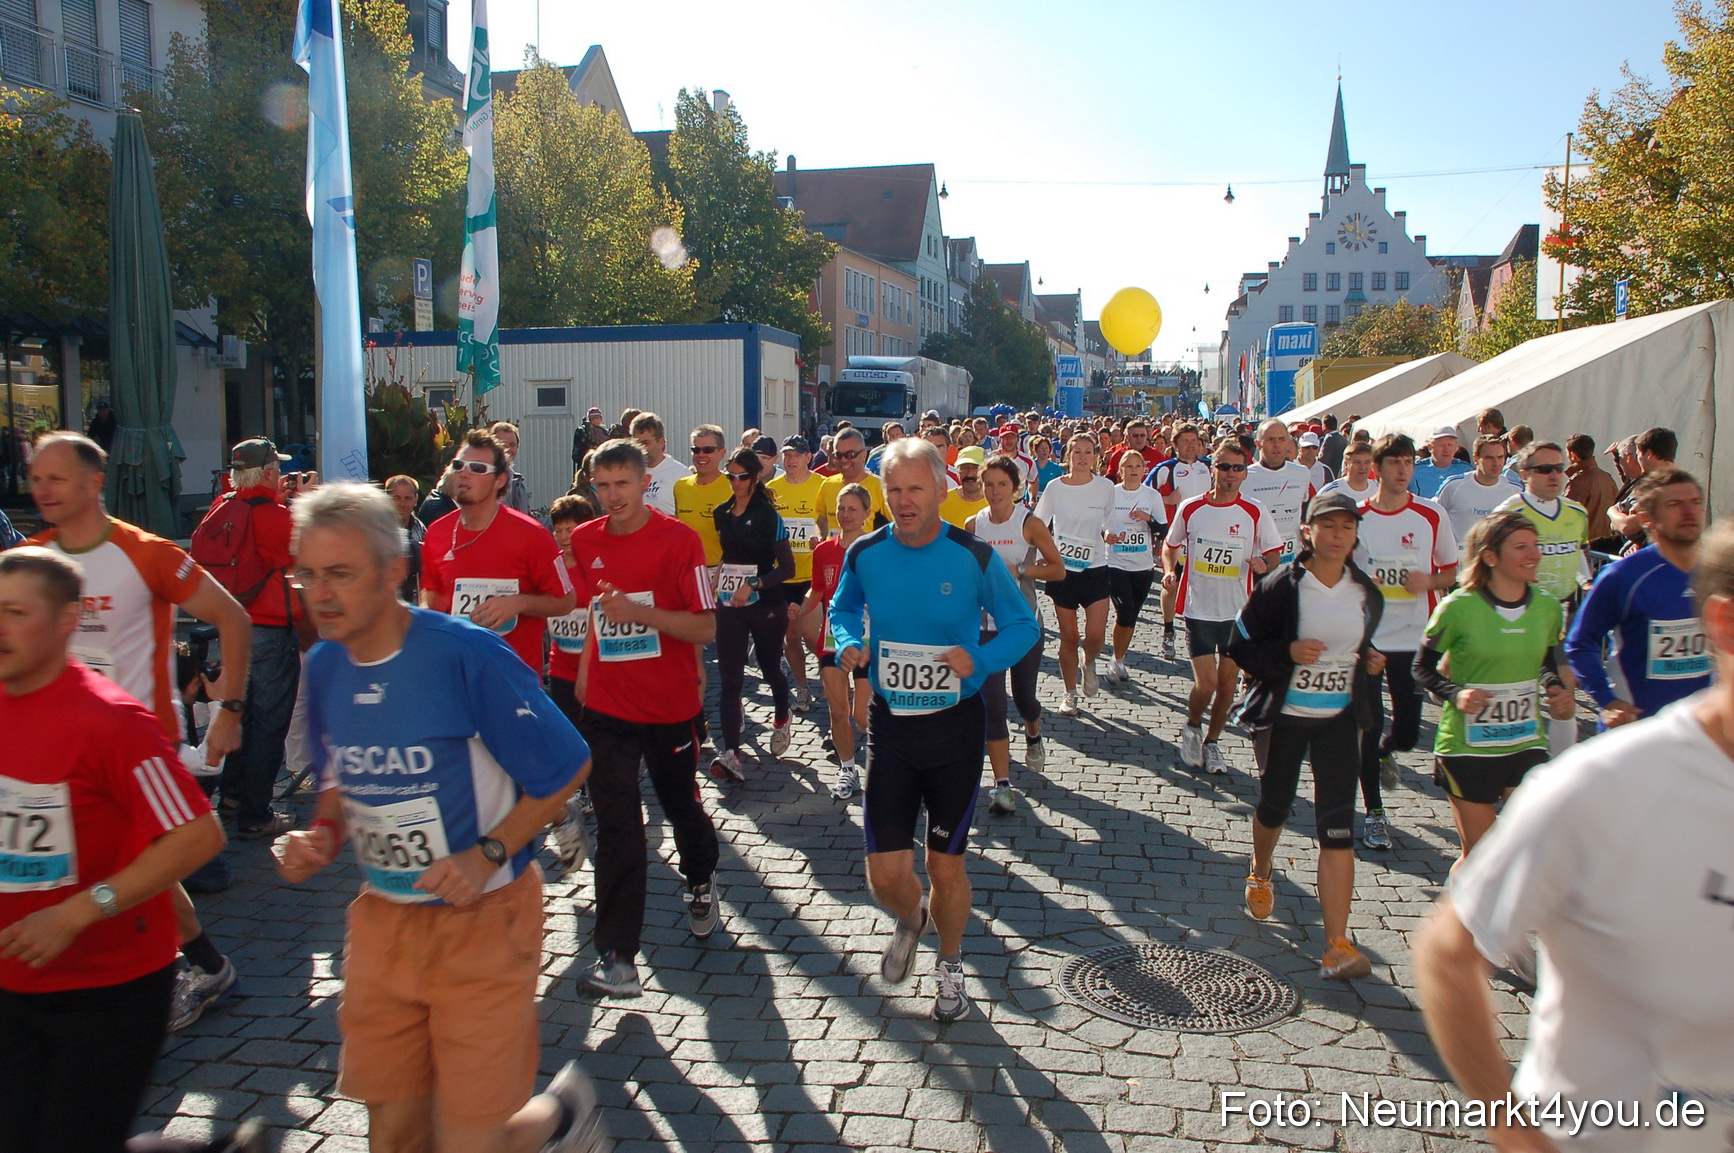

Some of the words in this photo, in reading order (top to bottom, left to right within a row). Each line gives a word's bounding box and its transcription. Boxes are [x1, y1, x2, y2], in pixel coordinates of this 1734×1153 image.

[417, 263, 428, 292] P
[1618, 285, 1625, 311] P
[1277, 331, 1313, 350] maxi
[1060, 361, 1077, 374] axi
[1060, 542, 1091, 561] 2260
[1203, 547, 1233, 565] 475
[1207, 563, 1226, 574] Ralf
[886, 661, 951, 691] 3032
[1296, 669, 1349, 692] 3455
[889, 691, 947, 707] Andreas
[0, 810, 55, 853] 72
